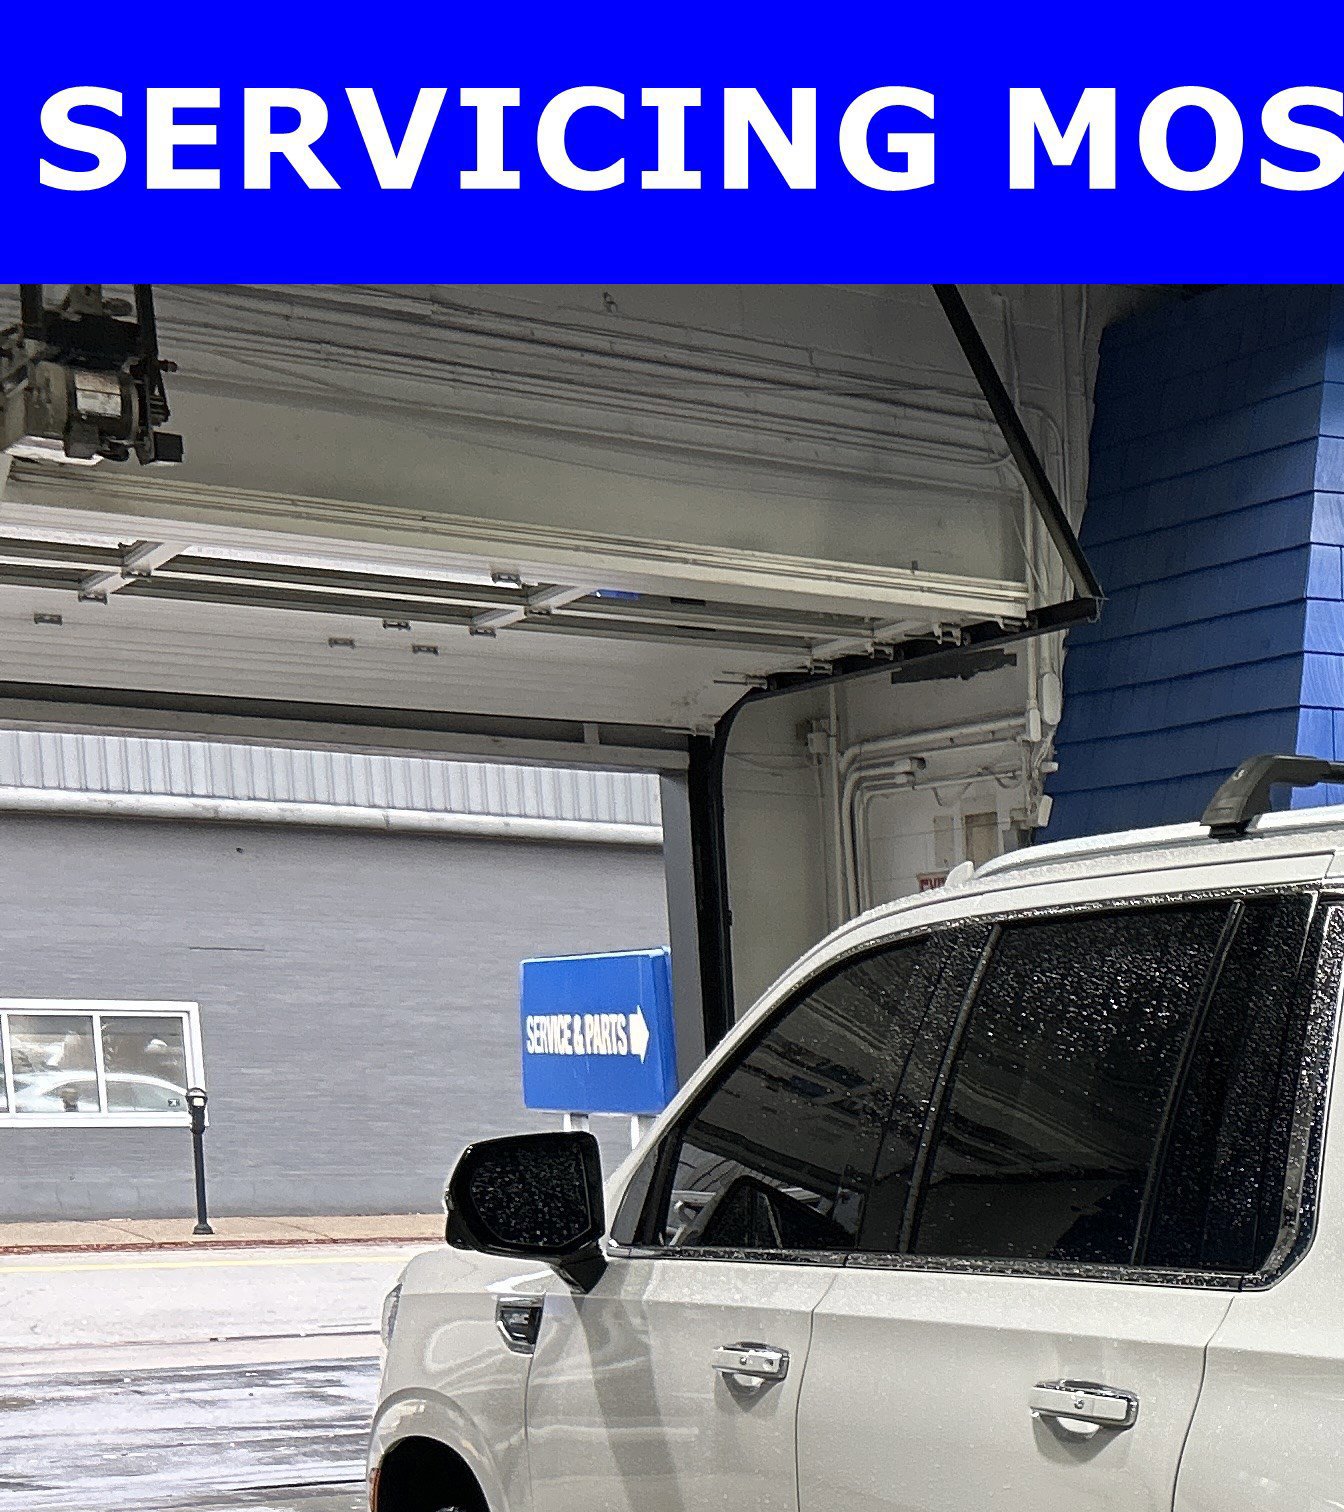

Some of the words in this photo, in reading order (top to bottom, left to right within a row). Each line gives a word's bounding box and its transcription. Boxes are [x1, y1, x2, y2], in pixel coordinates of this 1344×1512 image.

[526, 1014, 573, 1056] SERVICE
[573, 1014, 585, 1056] &
[584, 1013, 628, 1056] PARTS
